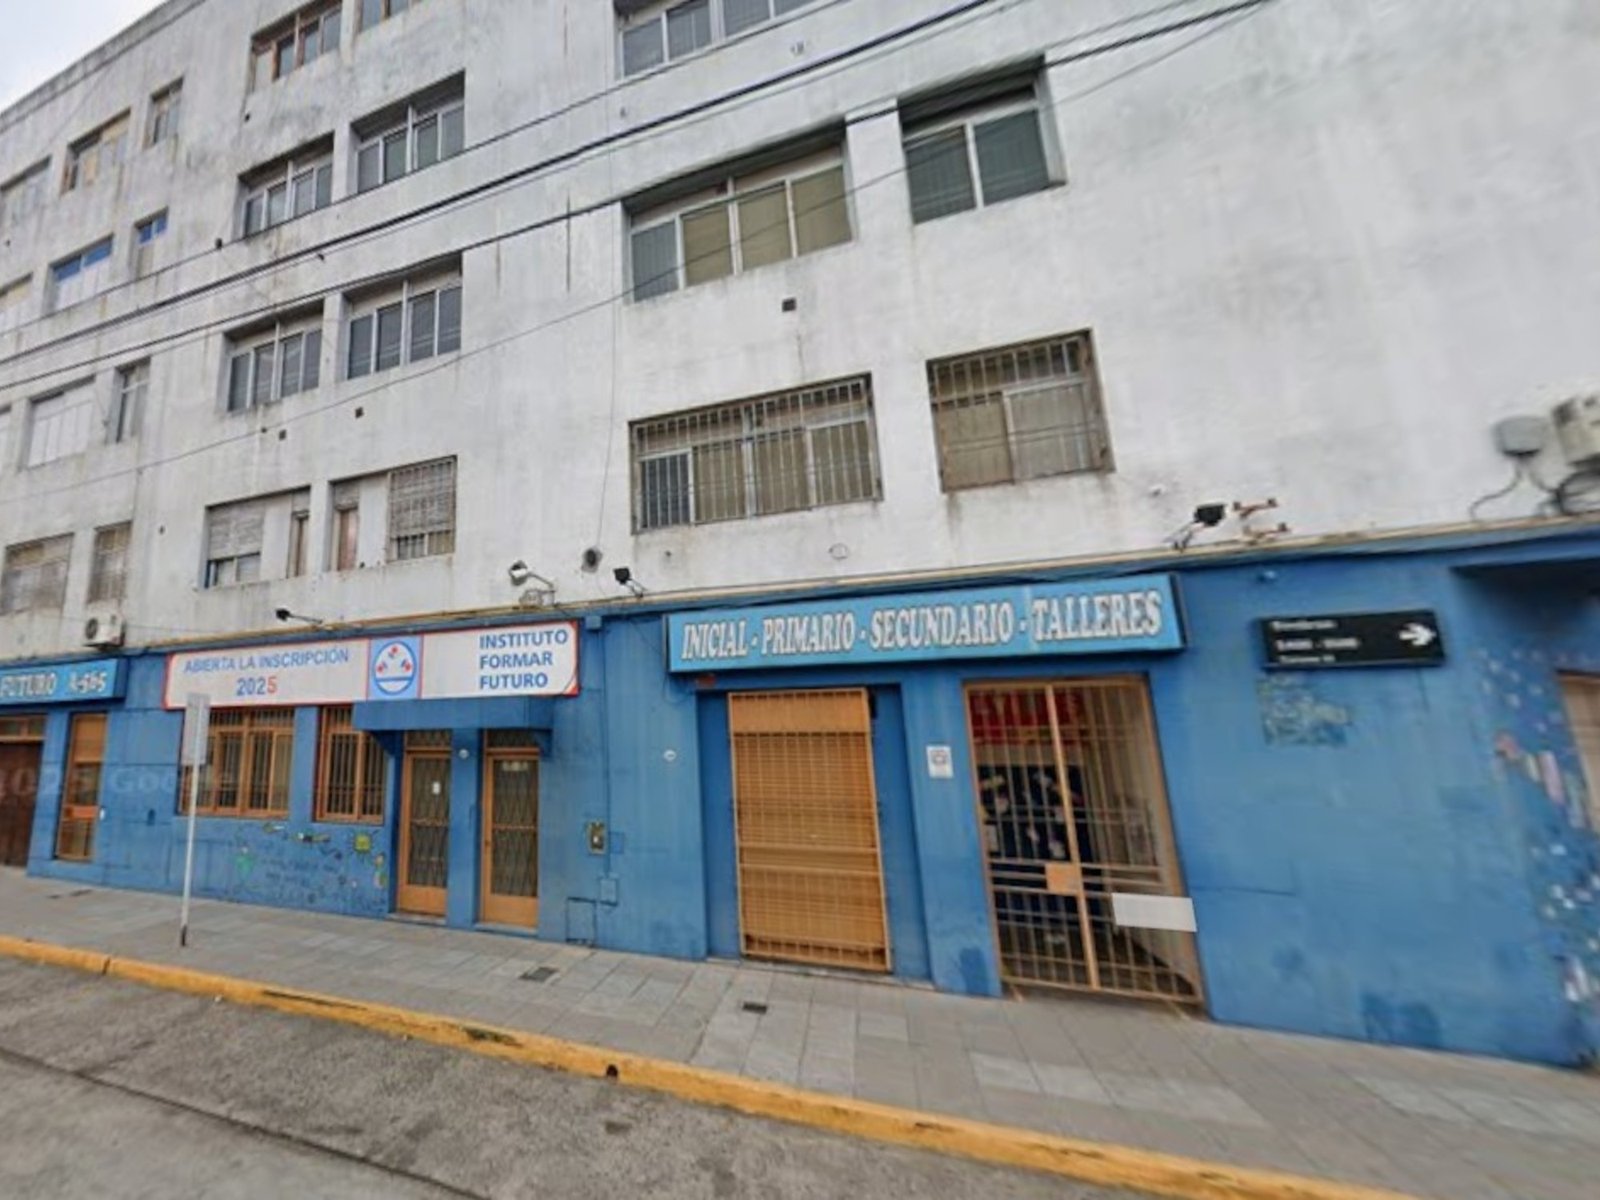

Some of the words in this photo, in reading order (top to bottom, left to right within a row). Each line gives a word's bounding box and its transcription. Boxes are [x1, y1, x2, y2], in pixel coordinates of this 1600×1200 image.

[681, 620, 748, 660] INICIAL
[761, 612, 856, 655] PRIMARIO
[869, 601, 1014, 649] SECUNDARIO
[1031, 590, 1162, 642] TALLERES
[479, 629, 569, 650] INSTITUTO
[184, 656, 236, 673] ABIERTA
[239, 656, 255, 671] LA
[259, 648, 350, 669] INSCRIPCIÓN
[479, 651, 553, 670] FORMAR
[236, 676, 279, 697] 2025
[479, 672, 549, 690] FUTURO
